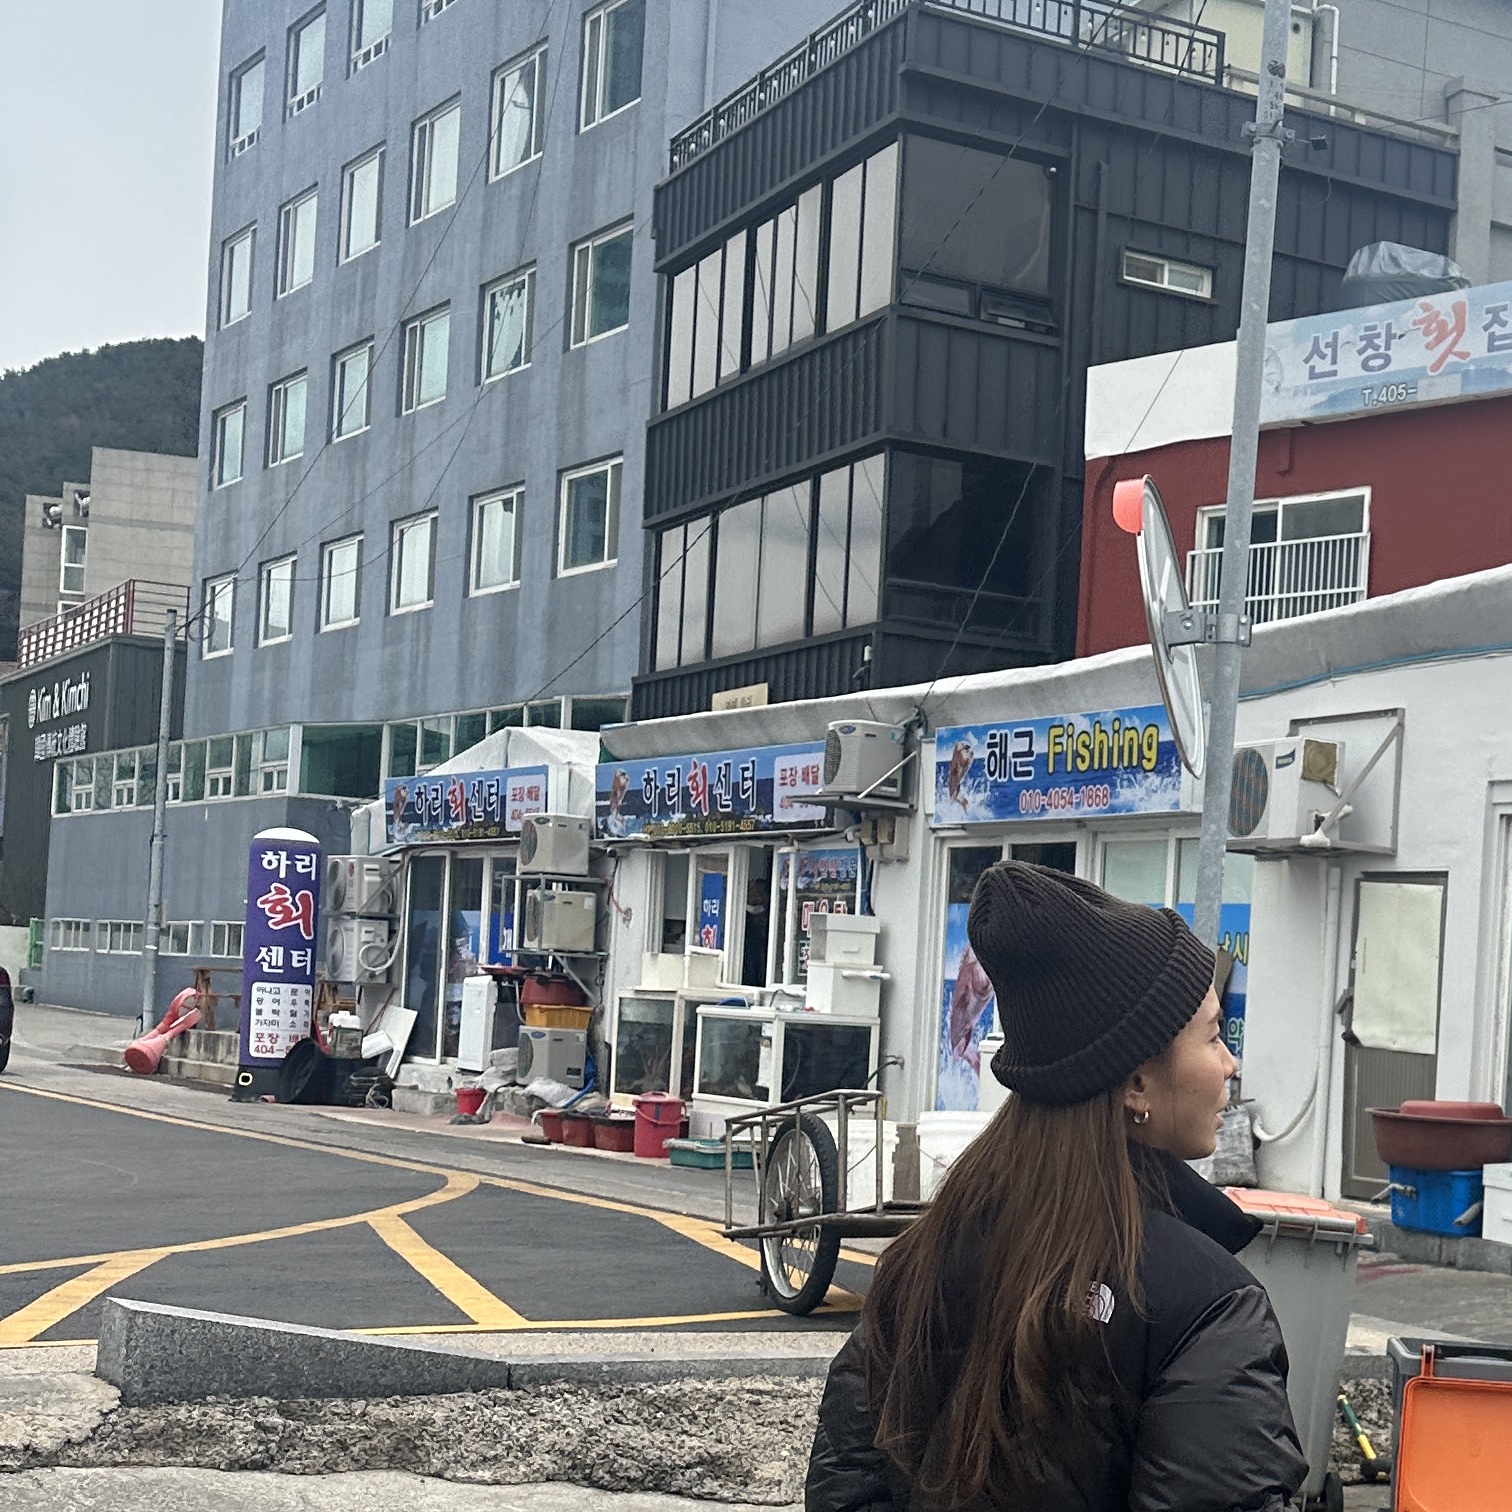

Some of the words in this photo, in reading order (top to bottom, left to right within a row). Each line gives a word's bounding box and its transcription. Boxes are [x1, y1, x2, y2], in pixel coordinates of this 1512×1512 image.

[1361, 384, 1418, 407] T.405-
[36, 686, 52, 723] Kim
[53, 682, 60, 719] &
[1047, 717, 1160, 775] Fishing
[260, 850, 317, 881] 하리
[257, 883, 314, 940] 회
[255, 945, 312, 976] 센터
